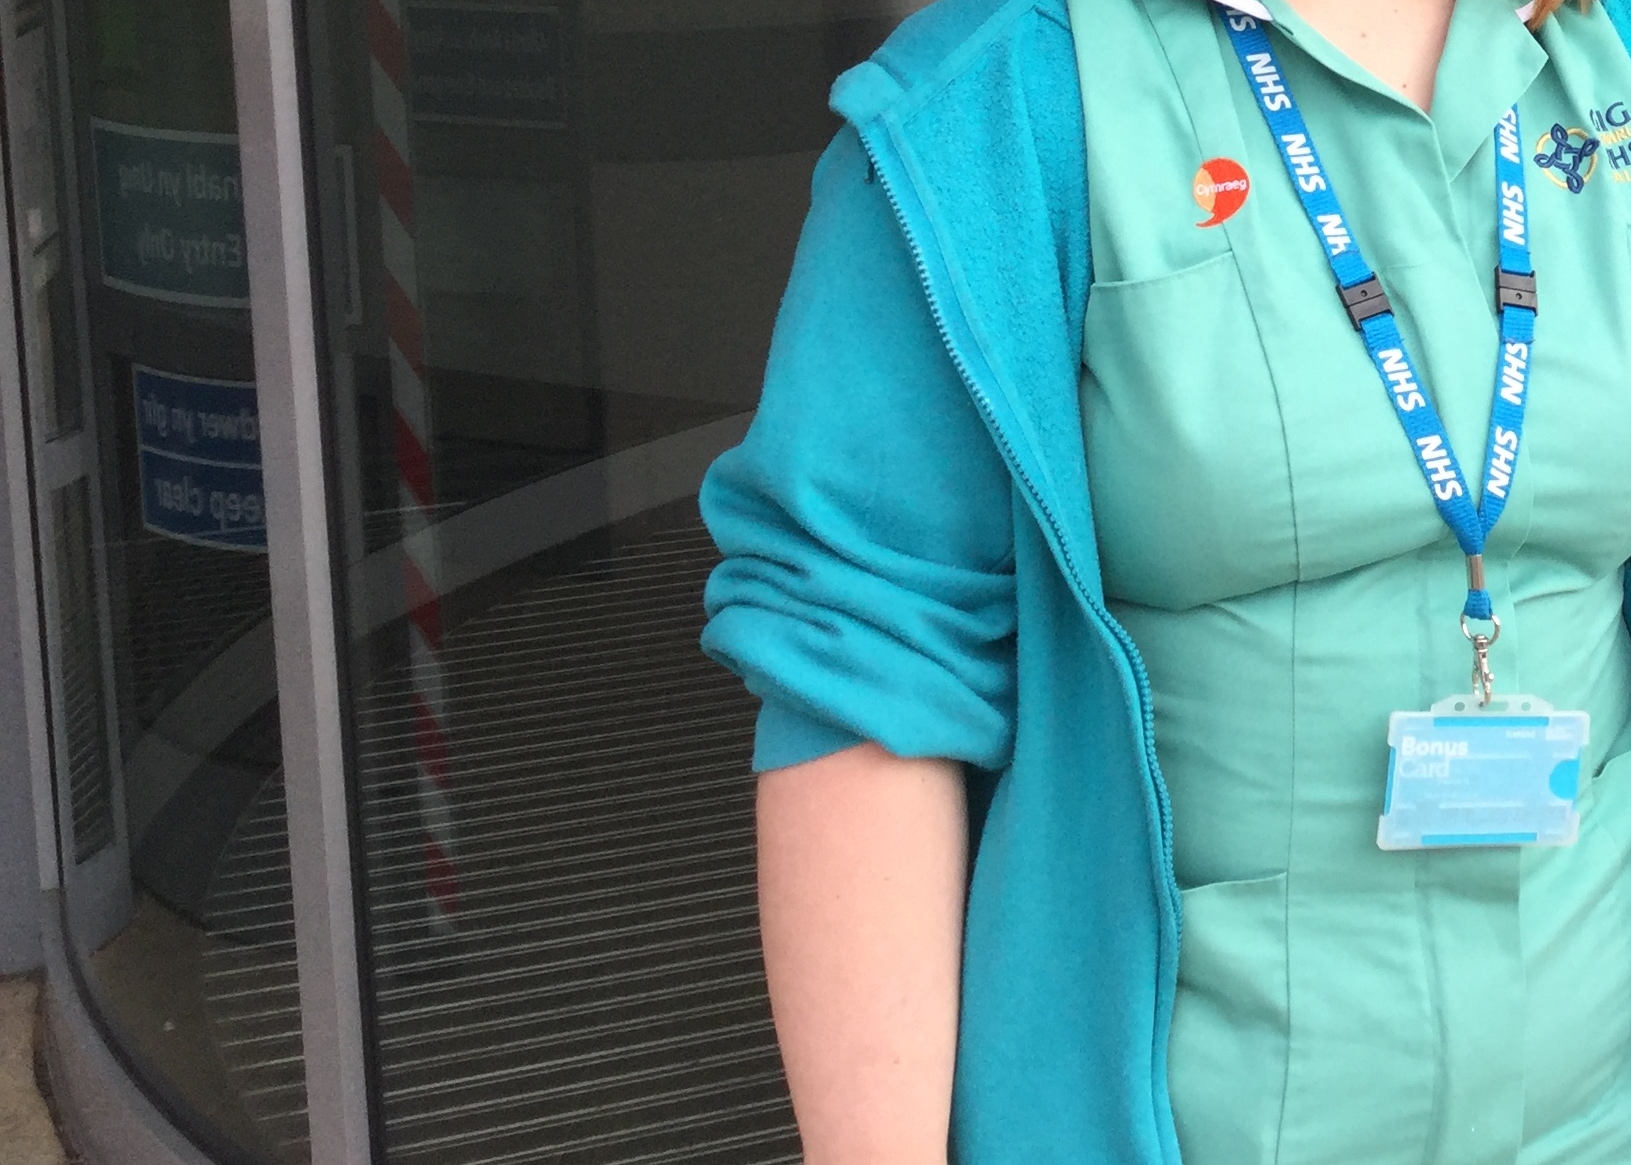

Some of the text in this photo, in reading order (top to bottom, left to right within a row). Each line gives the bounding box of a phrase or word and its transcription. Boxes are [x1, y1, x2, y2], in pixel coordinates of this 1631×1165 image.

[1246, 52, 1292, 112] NHS
[1281, 133, 1327, 193] NHS
[1502, 181, 1525, 246] NHS
[1378, 348, 1426, 412] NHS
[1500, 342, 1528, 406] NHS
[1416, 434, 1463, 501] NHS
[1487, 426, 1518, 499] NHS
[1399, 758, 1450, 778] Card
[1401, 735, 1469, 757] Bonus
